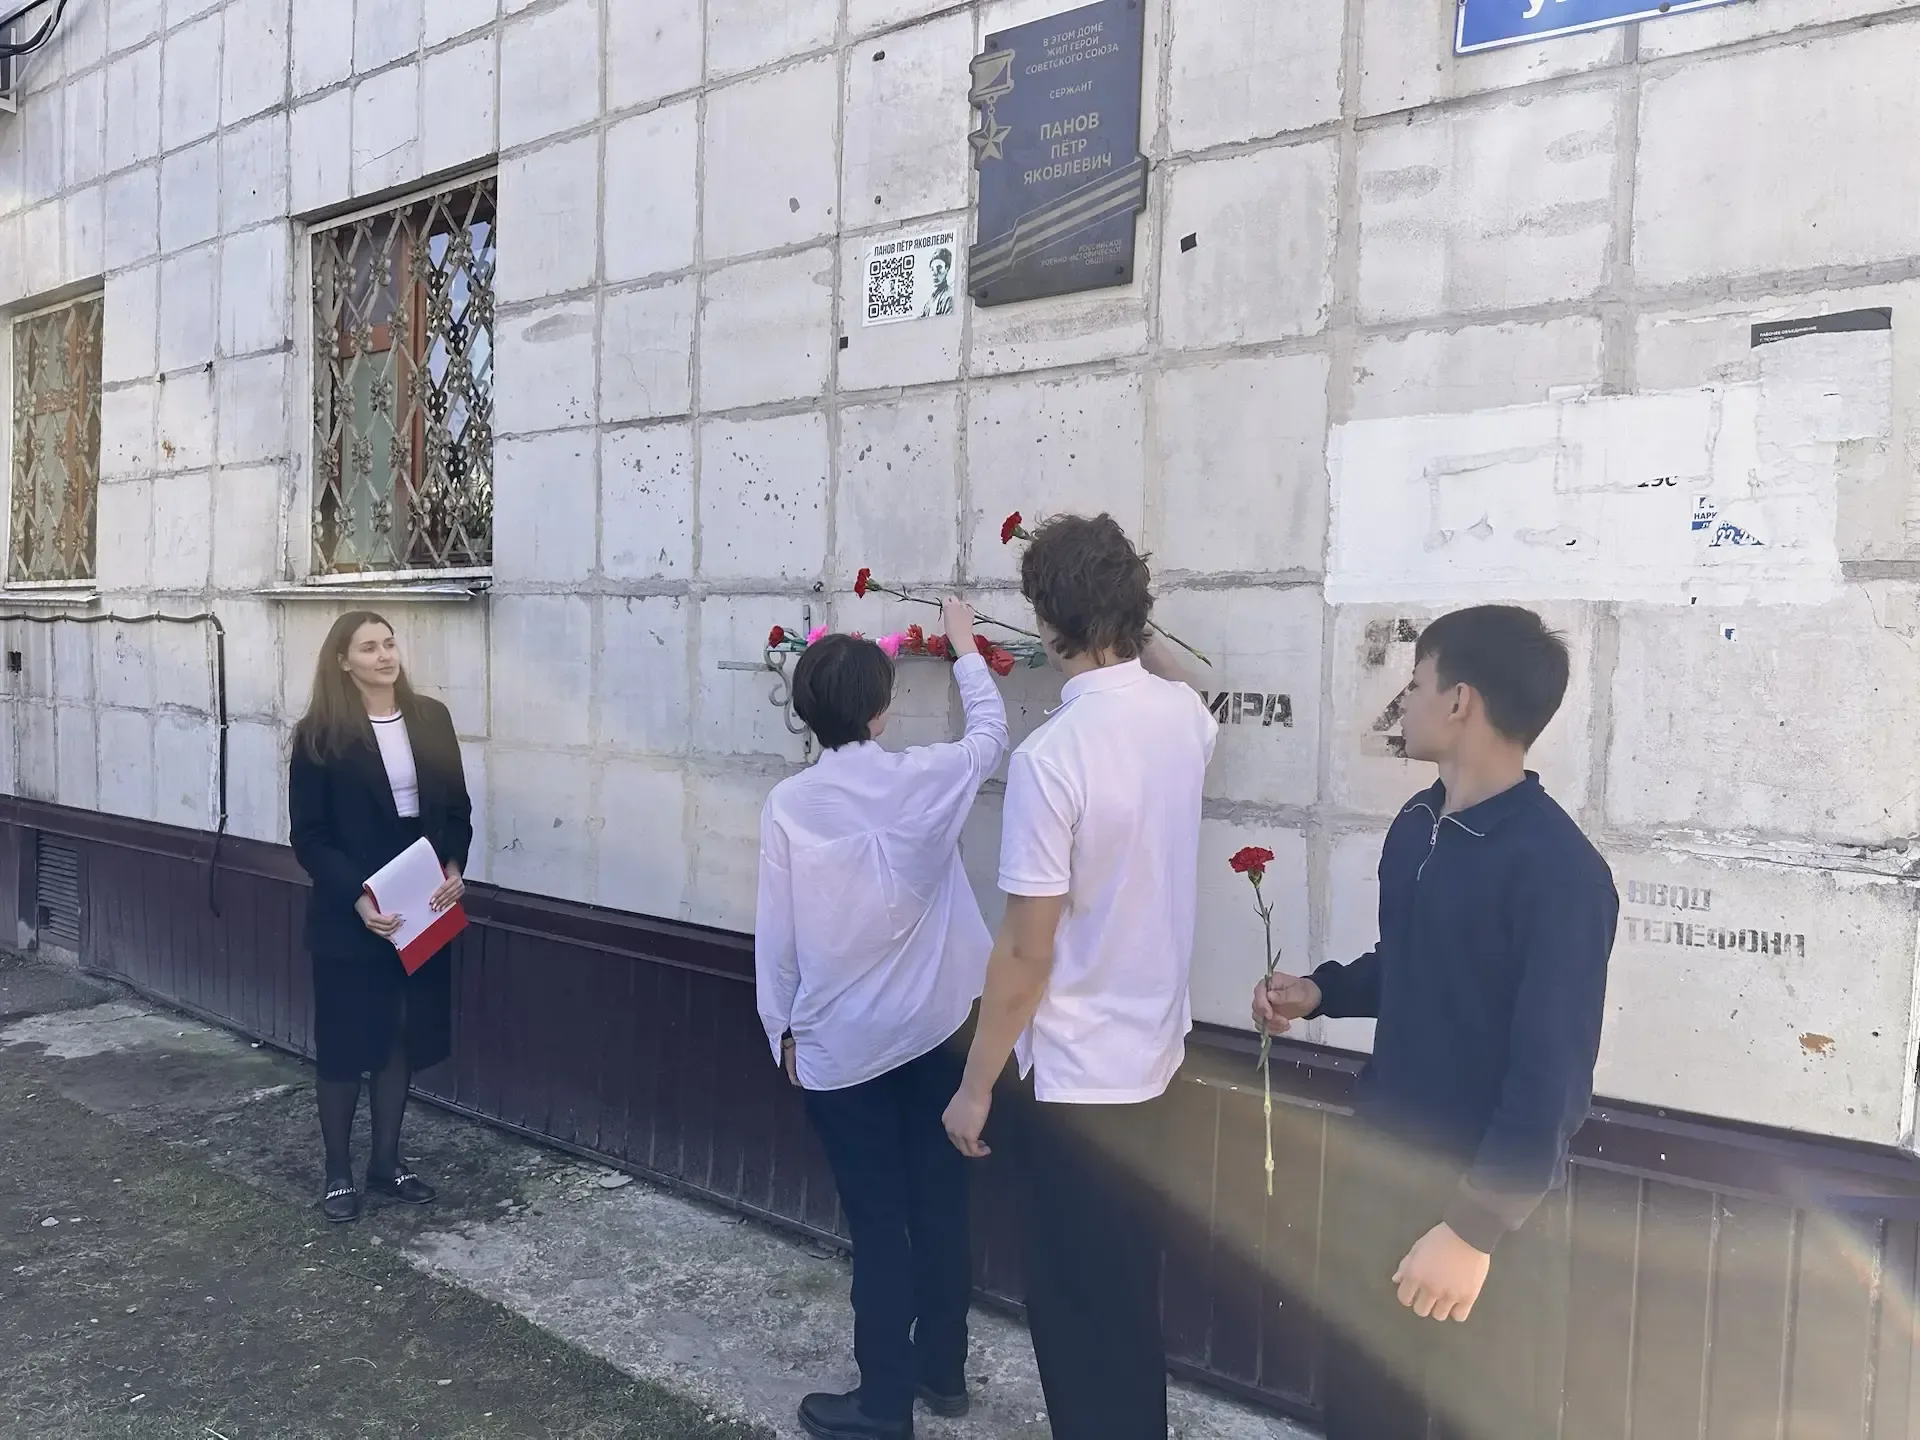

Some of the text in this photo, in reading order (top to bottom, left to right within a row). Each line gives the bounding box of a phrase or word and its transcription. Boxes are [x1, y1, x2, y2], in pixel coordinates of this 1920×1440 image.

[1043, 22, 1104, 47] В ЭТОМ ДОМЕ
[1025, 43, 1119, 75] СОВЕТСКОГО СОЮЗА
[1047, 44, 1068, 57] ЖИЛ
[1049, 80, 1093, 99] СЕРЖАНТ
[1040, 112, 1099, 140] ПАНОВ
[1051, 138, 1087, 159] ПЁТР
[1024, 152, 1112, 185] ЯКОВЛЕВИЧ
[874, 232, 954, 256] ПАНОВ ПЁТР ЯКОВЛЕВИЧ
[1628, 879, 1711, 911] ВВОД
[1624, 916, 1805, 958] ТЕЛЕФОНА
